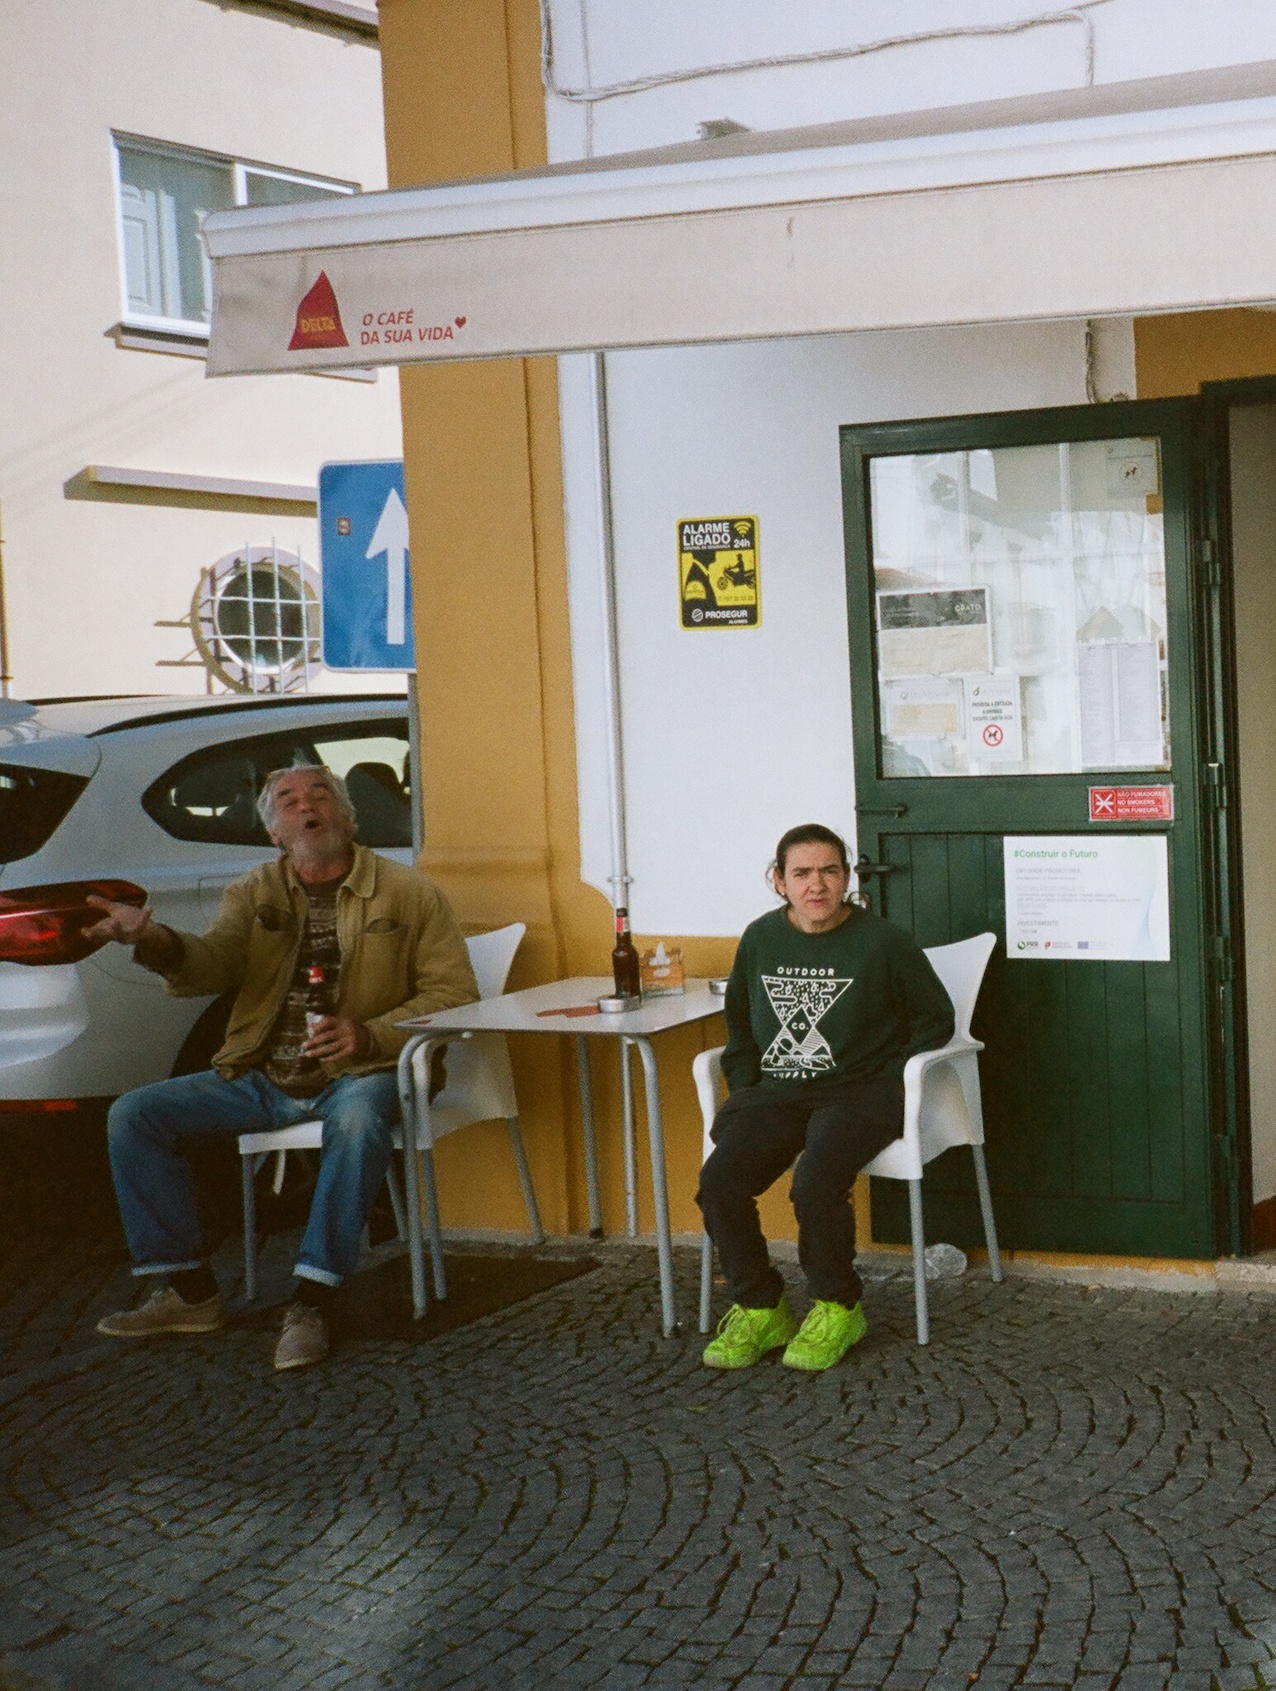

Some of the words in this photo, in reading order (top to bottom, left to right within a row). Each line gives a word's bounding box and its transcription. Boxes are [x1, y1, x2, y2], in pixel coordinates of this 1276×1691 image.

[362, 313, 373, 326] O
[377, 309, 414, 326] CAFÉ
[301, 316, 336, 333] DELTA
[360, 331, 380, 345] DA
[384, 329, 413, 344] SUA
[418, 326, 454, 342] VIDA
[683, 522, 730, 534] ALARME
[683, 533, 731, 546] LIGADO
[733, 538, 751, 548] 24h
[705, 610, 748, 619] PROSEGUR
[1014, 849, 1058, 858] #Construir
[1069, 849, 1098, 858] Futuro
[777, 966, 835, 976] OUTDOOR
[791, 1022, 809, 1030] CO.
